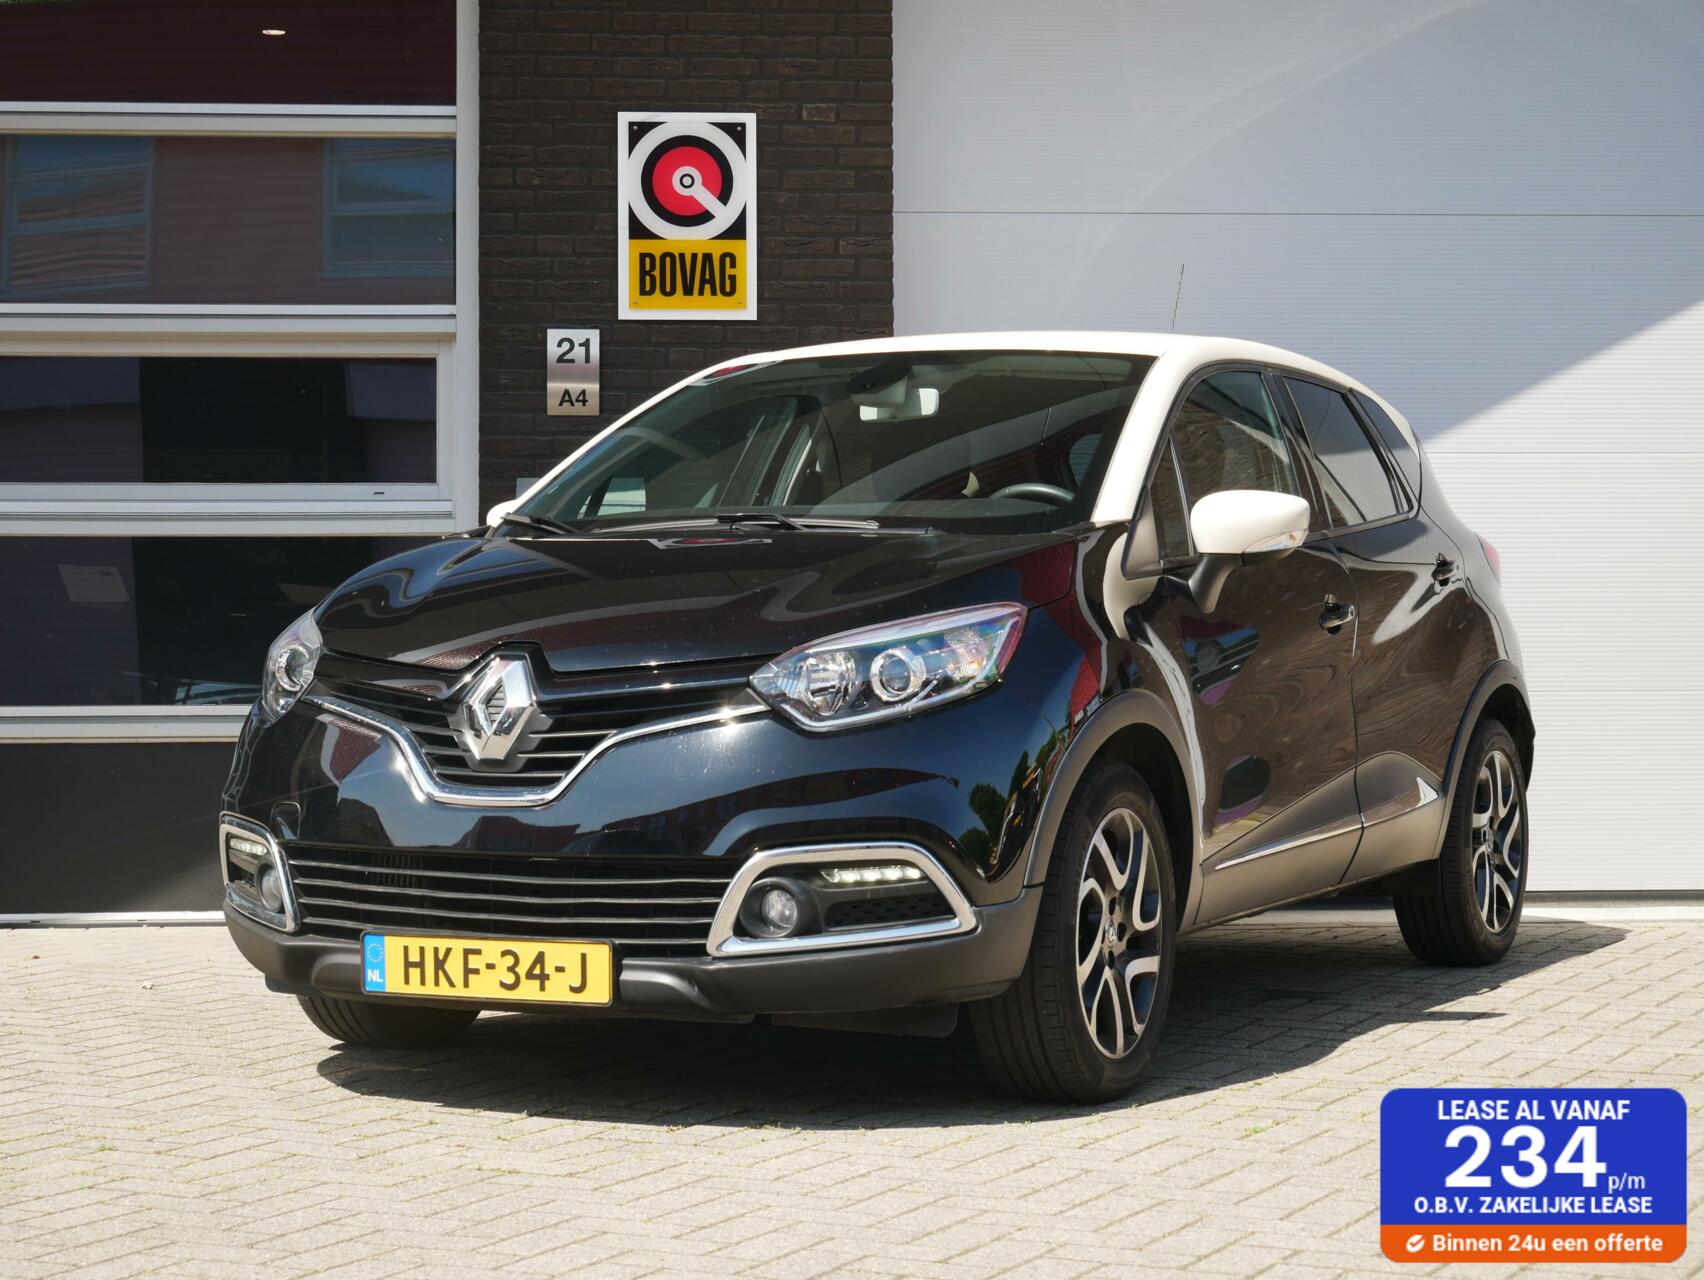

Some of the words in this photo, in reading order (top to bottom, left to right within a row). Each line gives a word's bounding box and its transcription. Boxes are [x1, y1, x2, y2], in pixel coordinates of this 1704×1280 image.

[638, 251, 737, 297] BOVAG
[556, 337, 591, 364] 21
[558, 389, 588, 407] A4
[367, 969, 384, 983] NL
[402, 945, 588, 994] HKF-34-J
